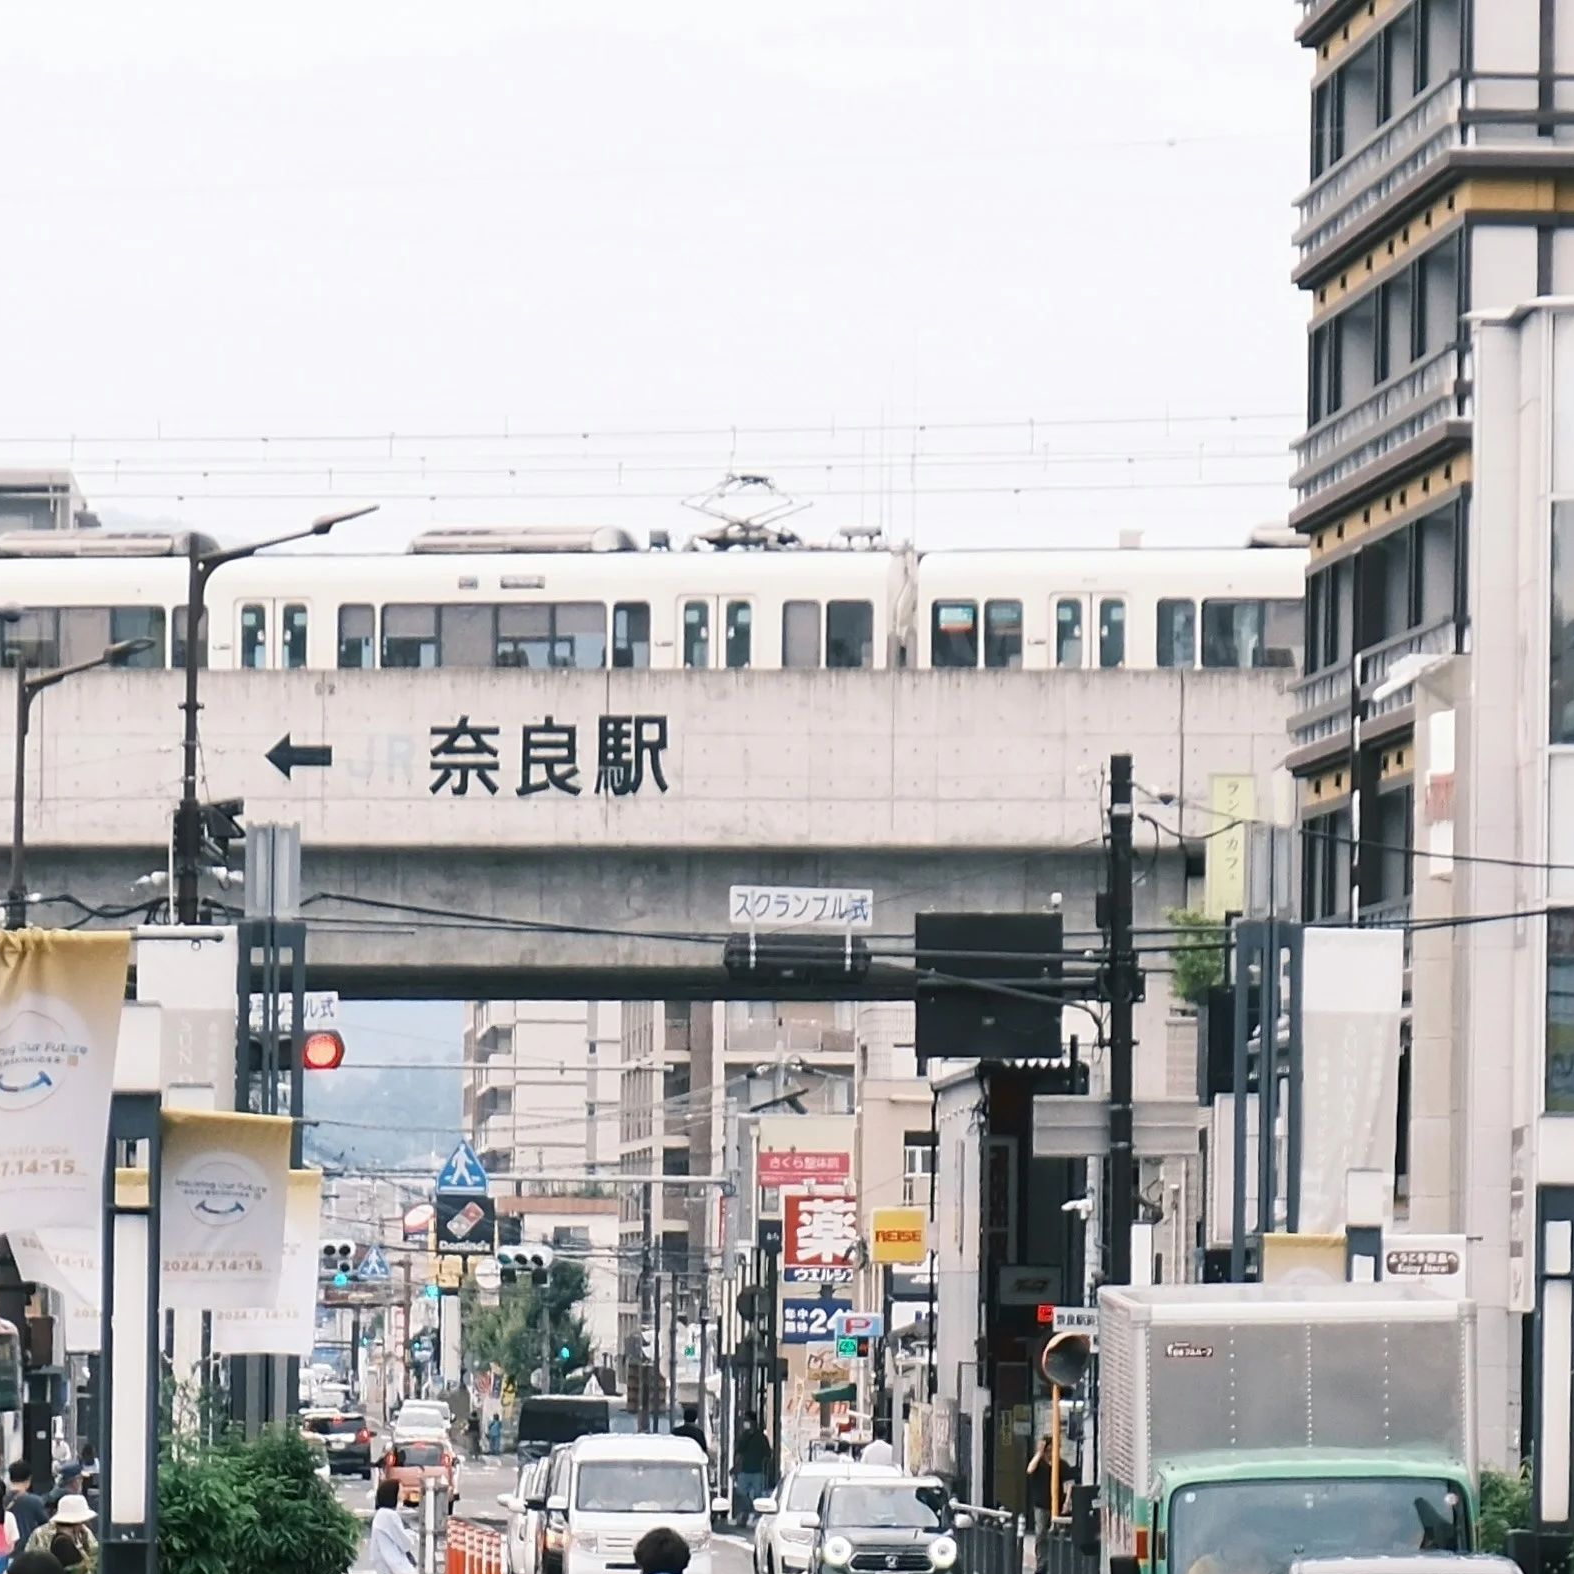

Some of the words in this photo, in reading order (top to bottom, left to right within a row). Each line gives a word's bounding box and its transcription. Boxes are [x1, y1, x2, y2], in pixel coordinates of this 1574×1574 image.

[429, 714, 669, 796] 奈良駅
[796, 1198, 857, 1263] 薬
[845, 1317, 872, 1334] P
